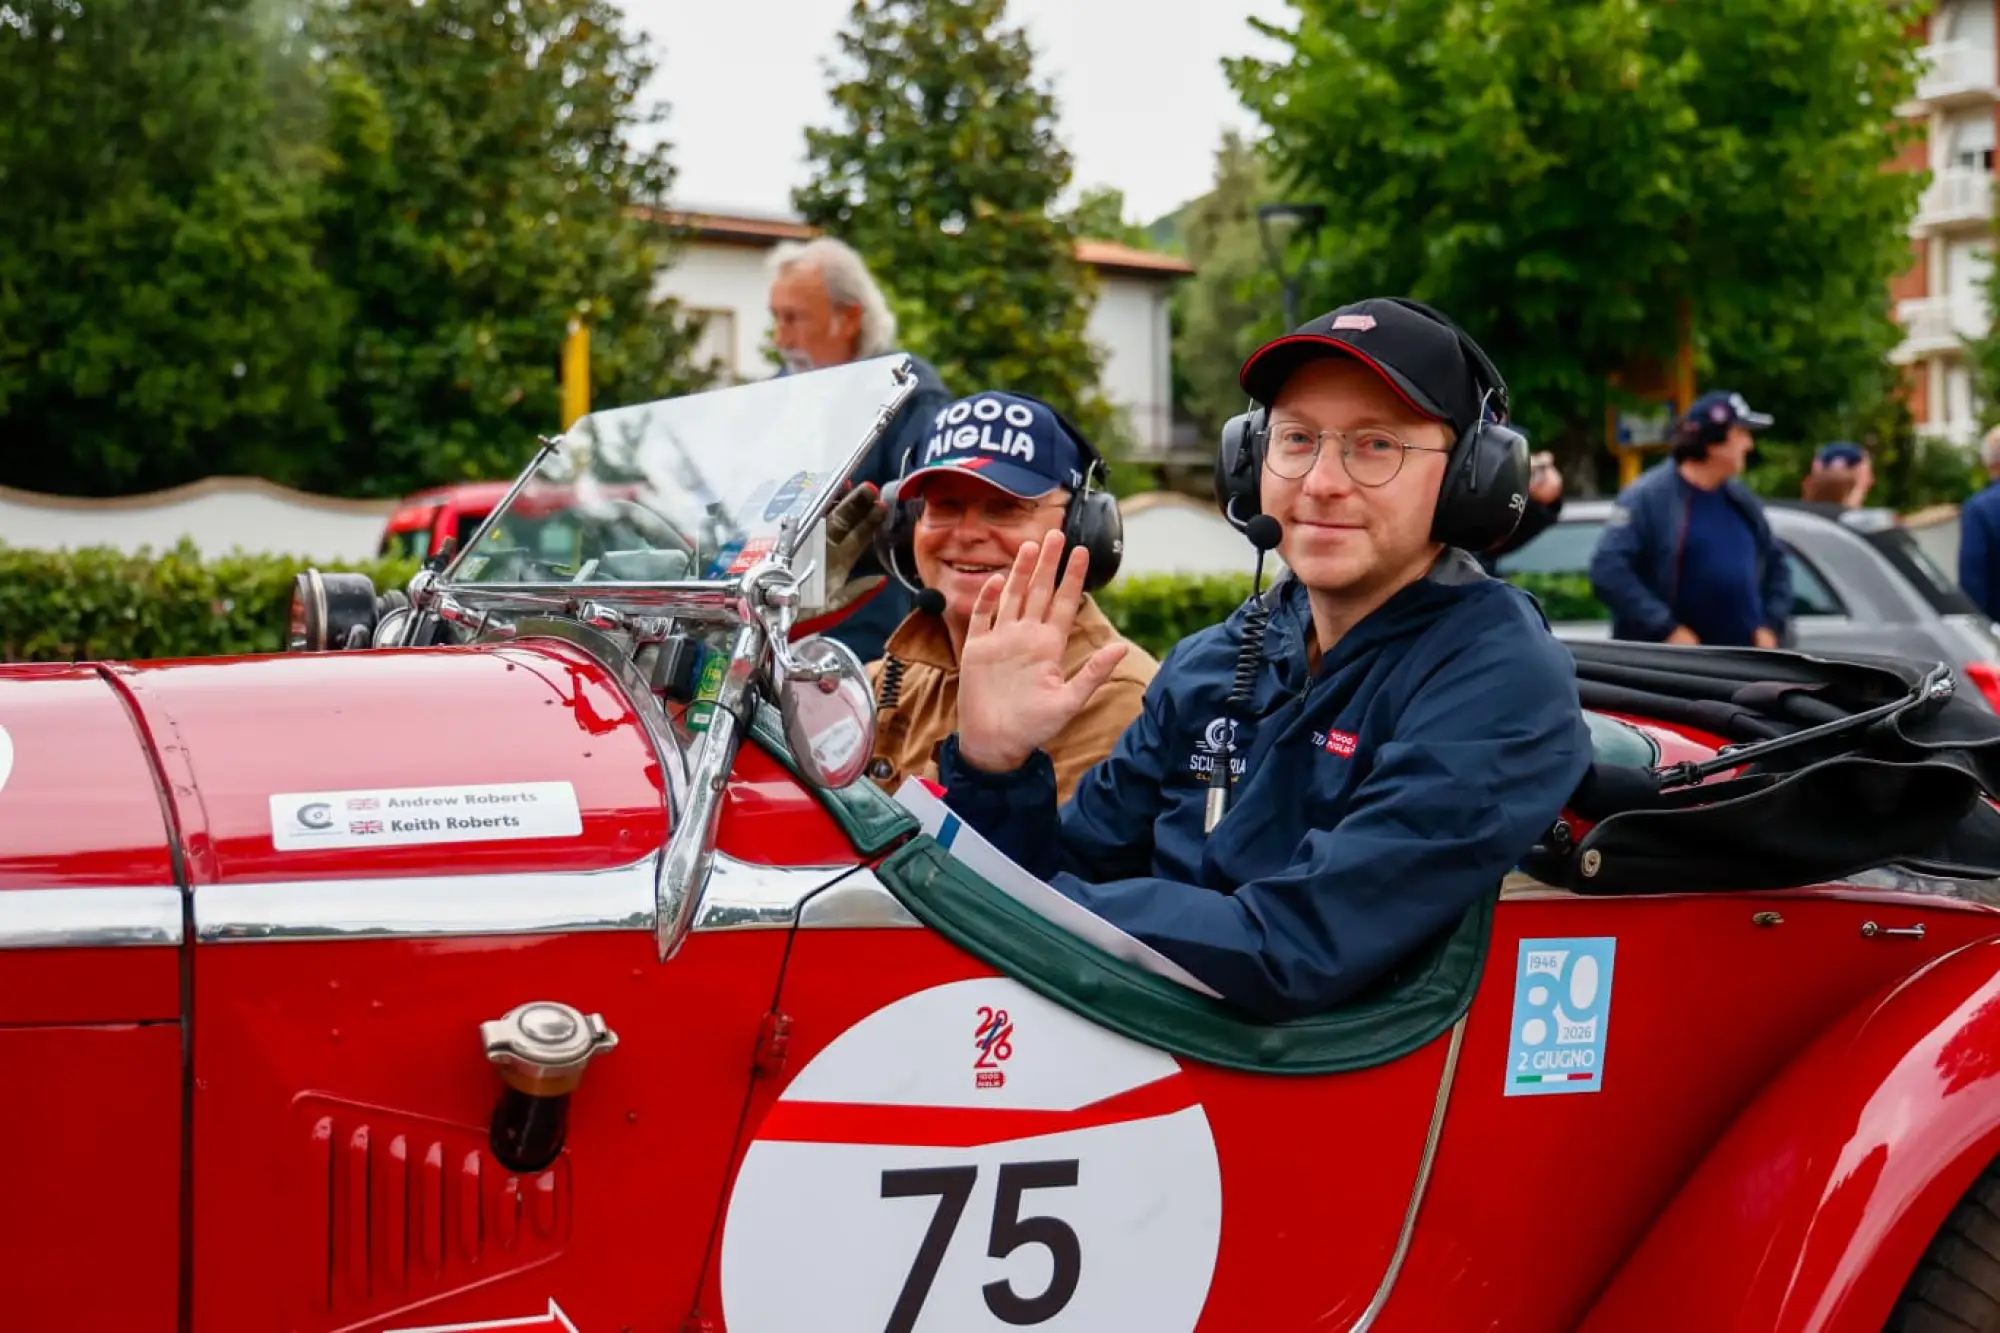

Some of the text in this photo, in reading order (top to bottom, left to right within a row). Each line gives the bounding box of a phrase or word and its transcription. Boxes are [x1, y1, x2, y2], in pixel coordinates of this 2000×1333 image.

[935, 398, 1034, 431] 1000
[923, 424, 1036, 466] MIGLIA
[1189, 754, 1247, 774] SCURIA
[388, 792, 538, 808] Andrew Roberts
[391, 815, 520, 832] Keith Roberts
[1529, 955, 1557, 970] 1946
[1563, 1026, 1592, 1040] 2026
[1516, 1049, 1595, 1072] 2 GIUGNO
[880, 1158, 1082, 1333] 75
